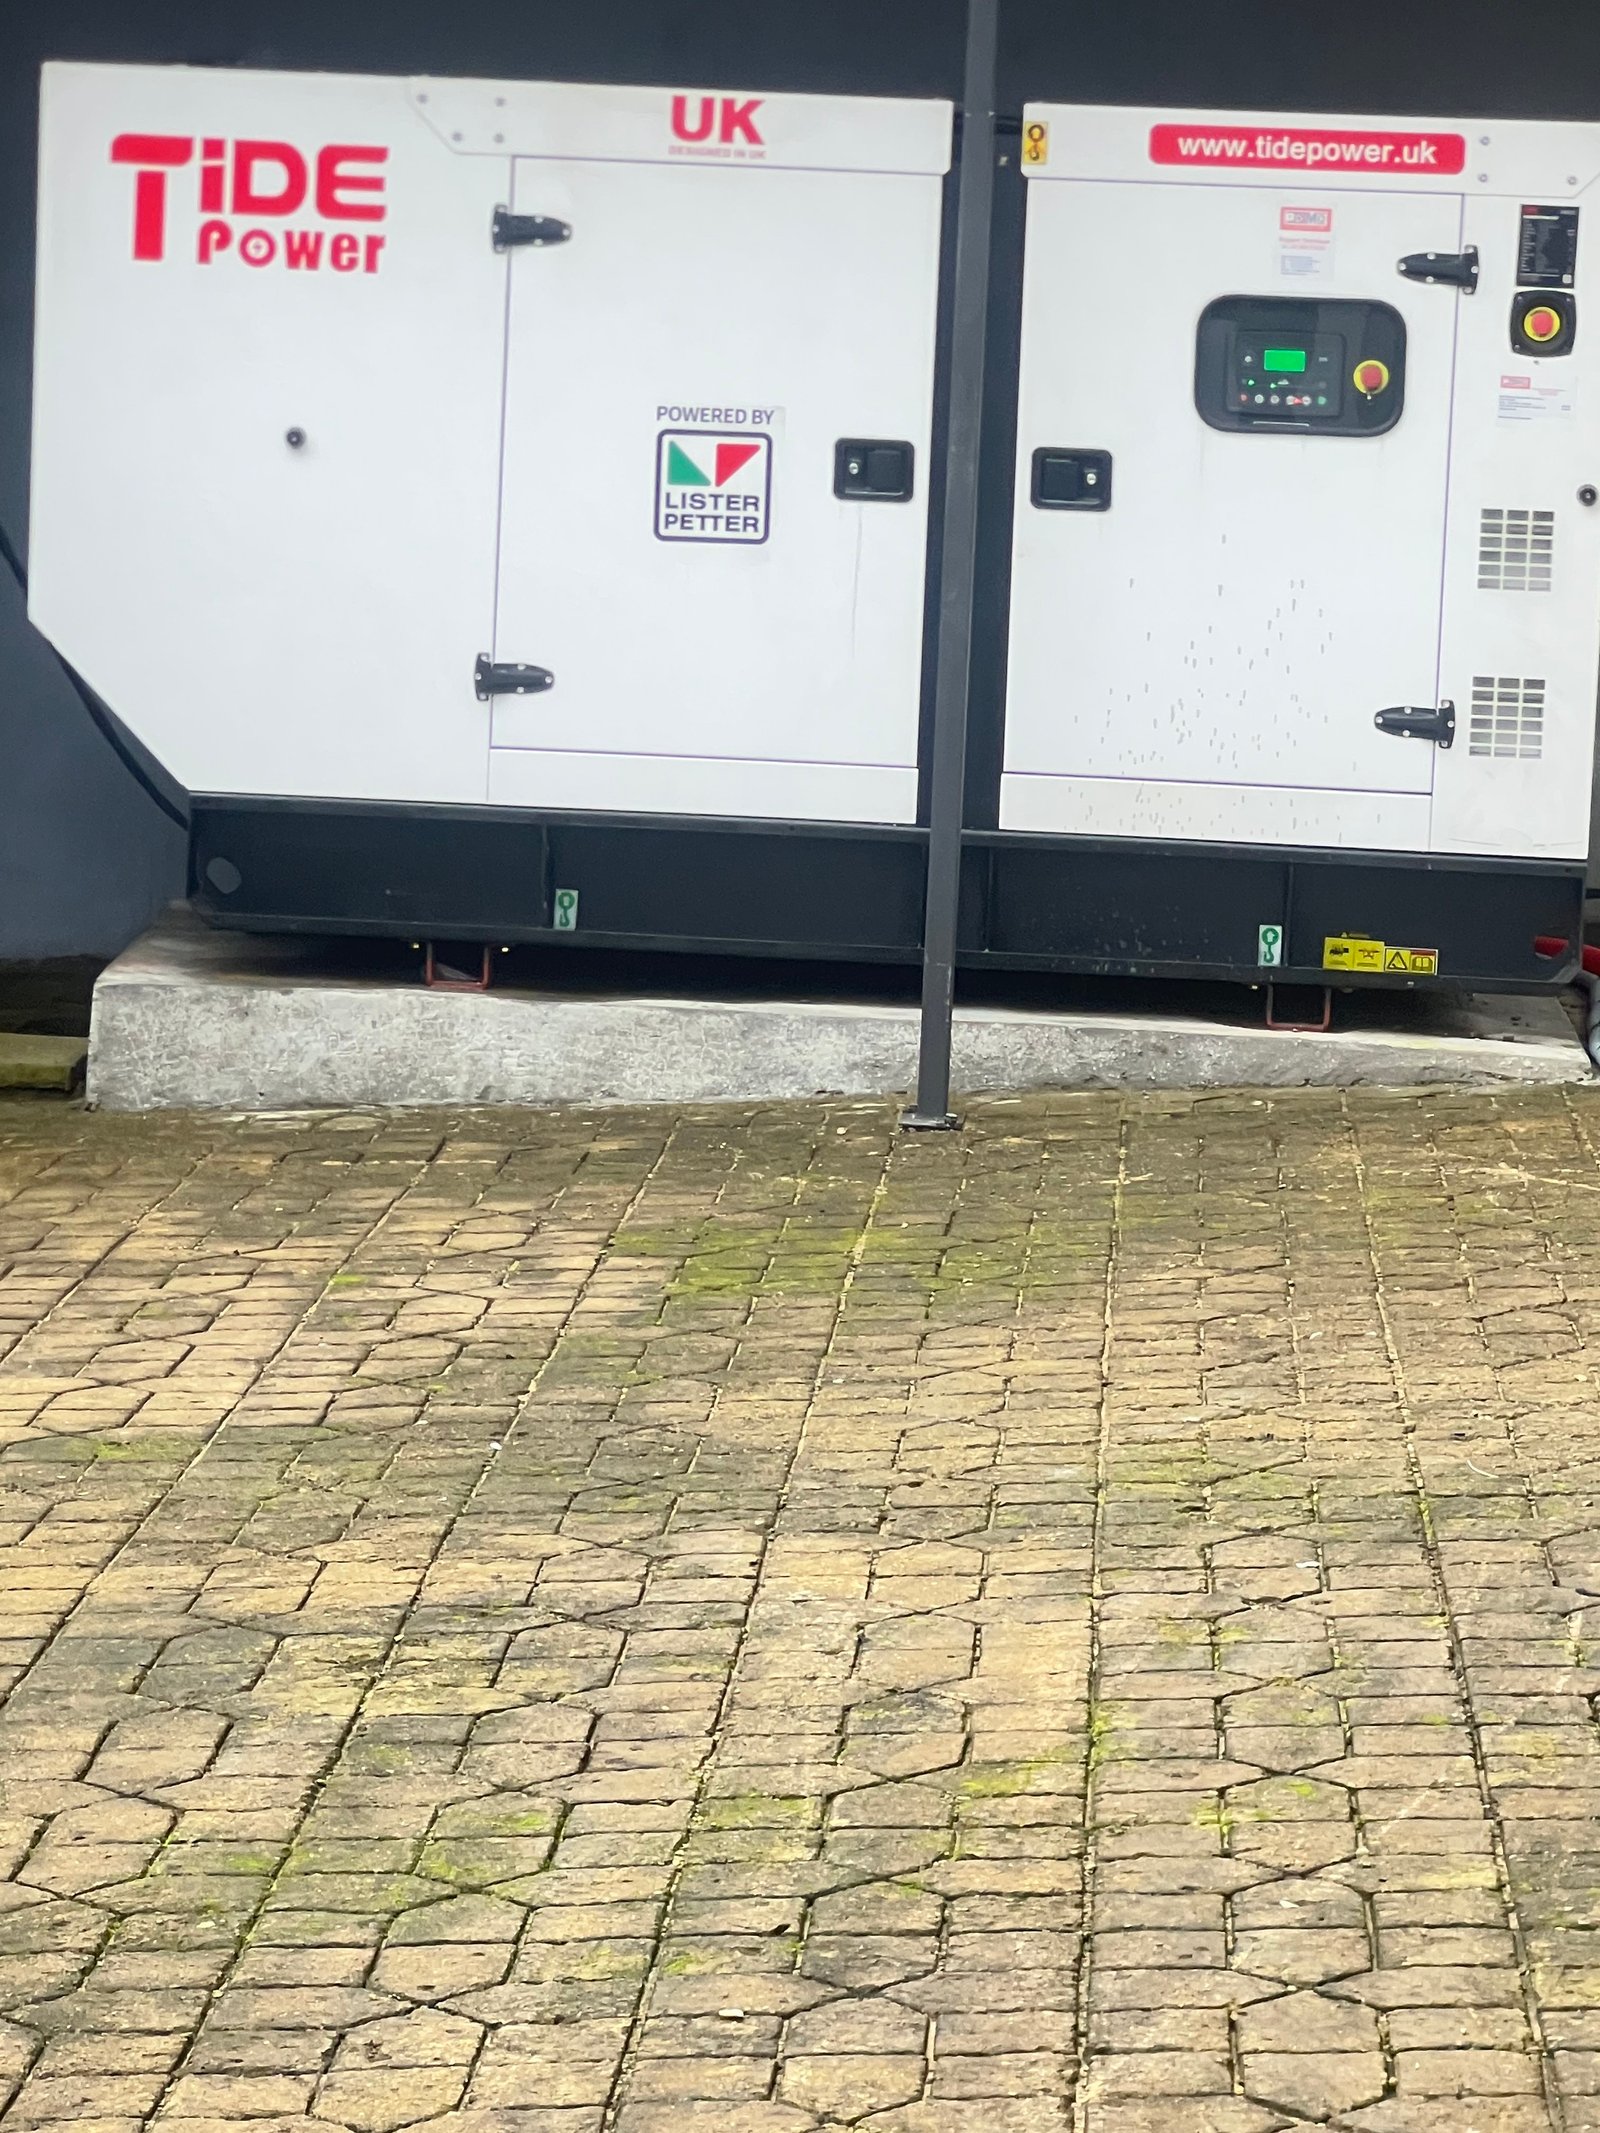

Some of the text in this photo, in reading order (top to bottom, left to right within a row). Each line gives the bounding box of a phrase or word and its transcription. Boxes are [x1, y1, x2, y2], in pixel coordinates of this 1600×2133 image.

[672, 95, 765, 145] UK
[1177, 135, 1437, 165] www.tidepower.uk
[656, 405, 775, 425] POWERED BY
[665, 492, 760, 512] LISTER
[664, 513, 760, 533] PETTER
